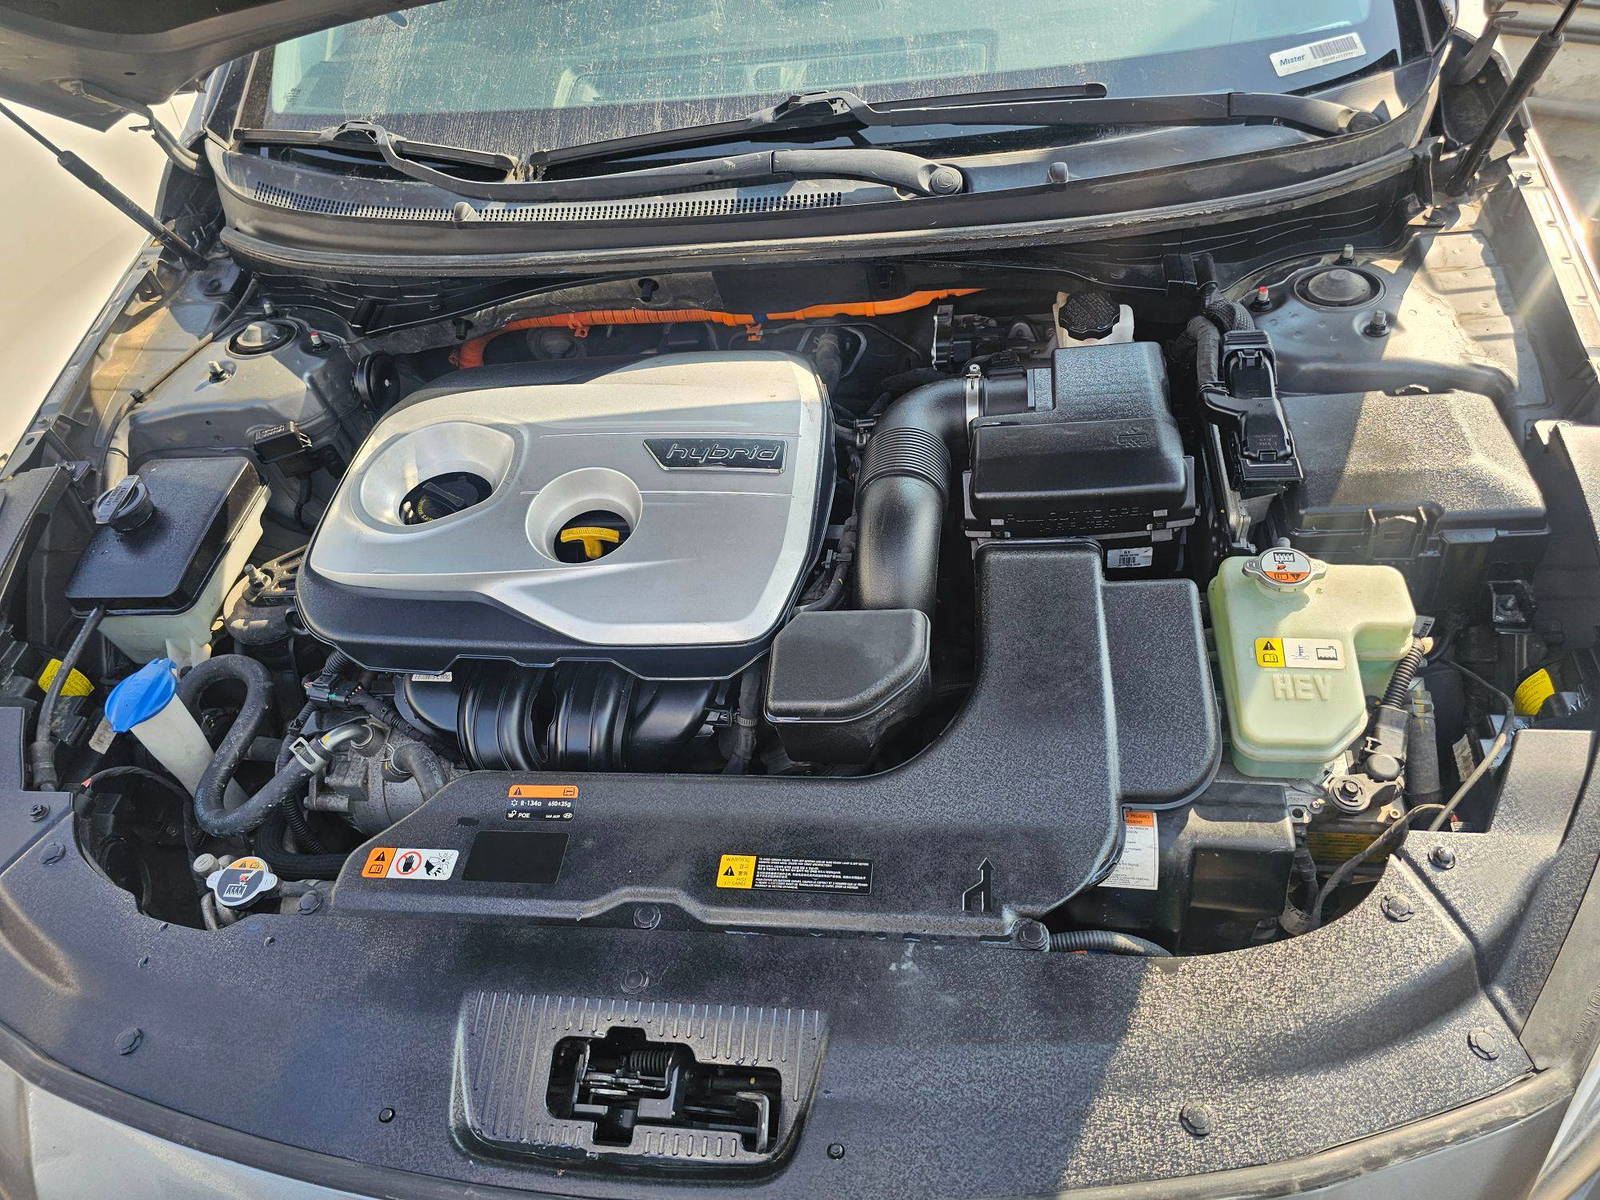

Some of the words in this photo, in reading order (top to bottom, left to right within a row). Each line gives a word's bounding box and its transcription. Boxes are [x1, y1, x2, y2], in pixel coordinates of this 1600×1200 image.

[1280, 54, 1305, 66] Mister
[666, 443, 780, 463] hybrid
[1272, 672, 1333, 702] HEV
